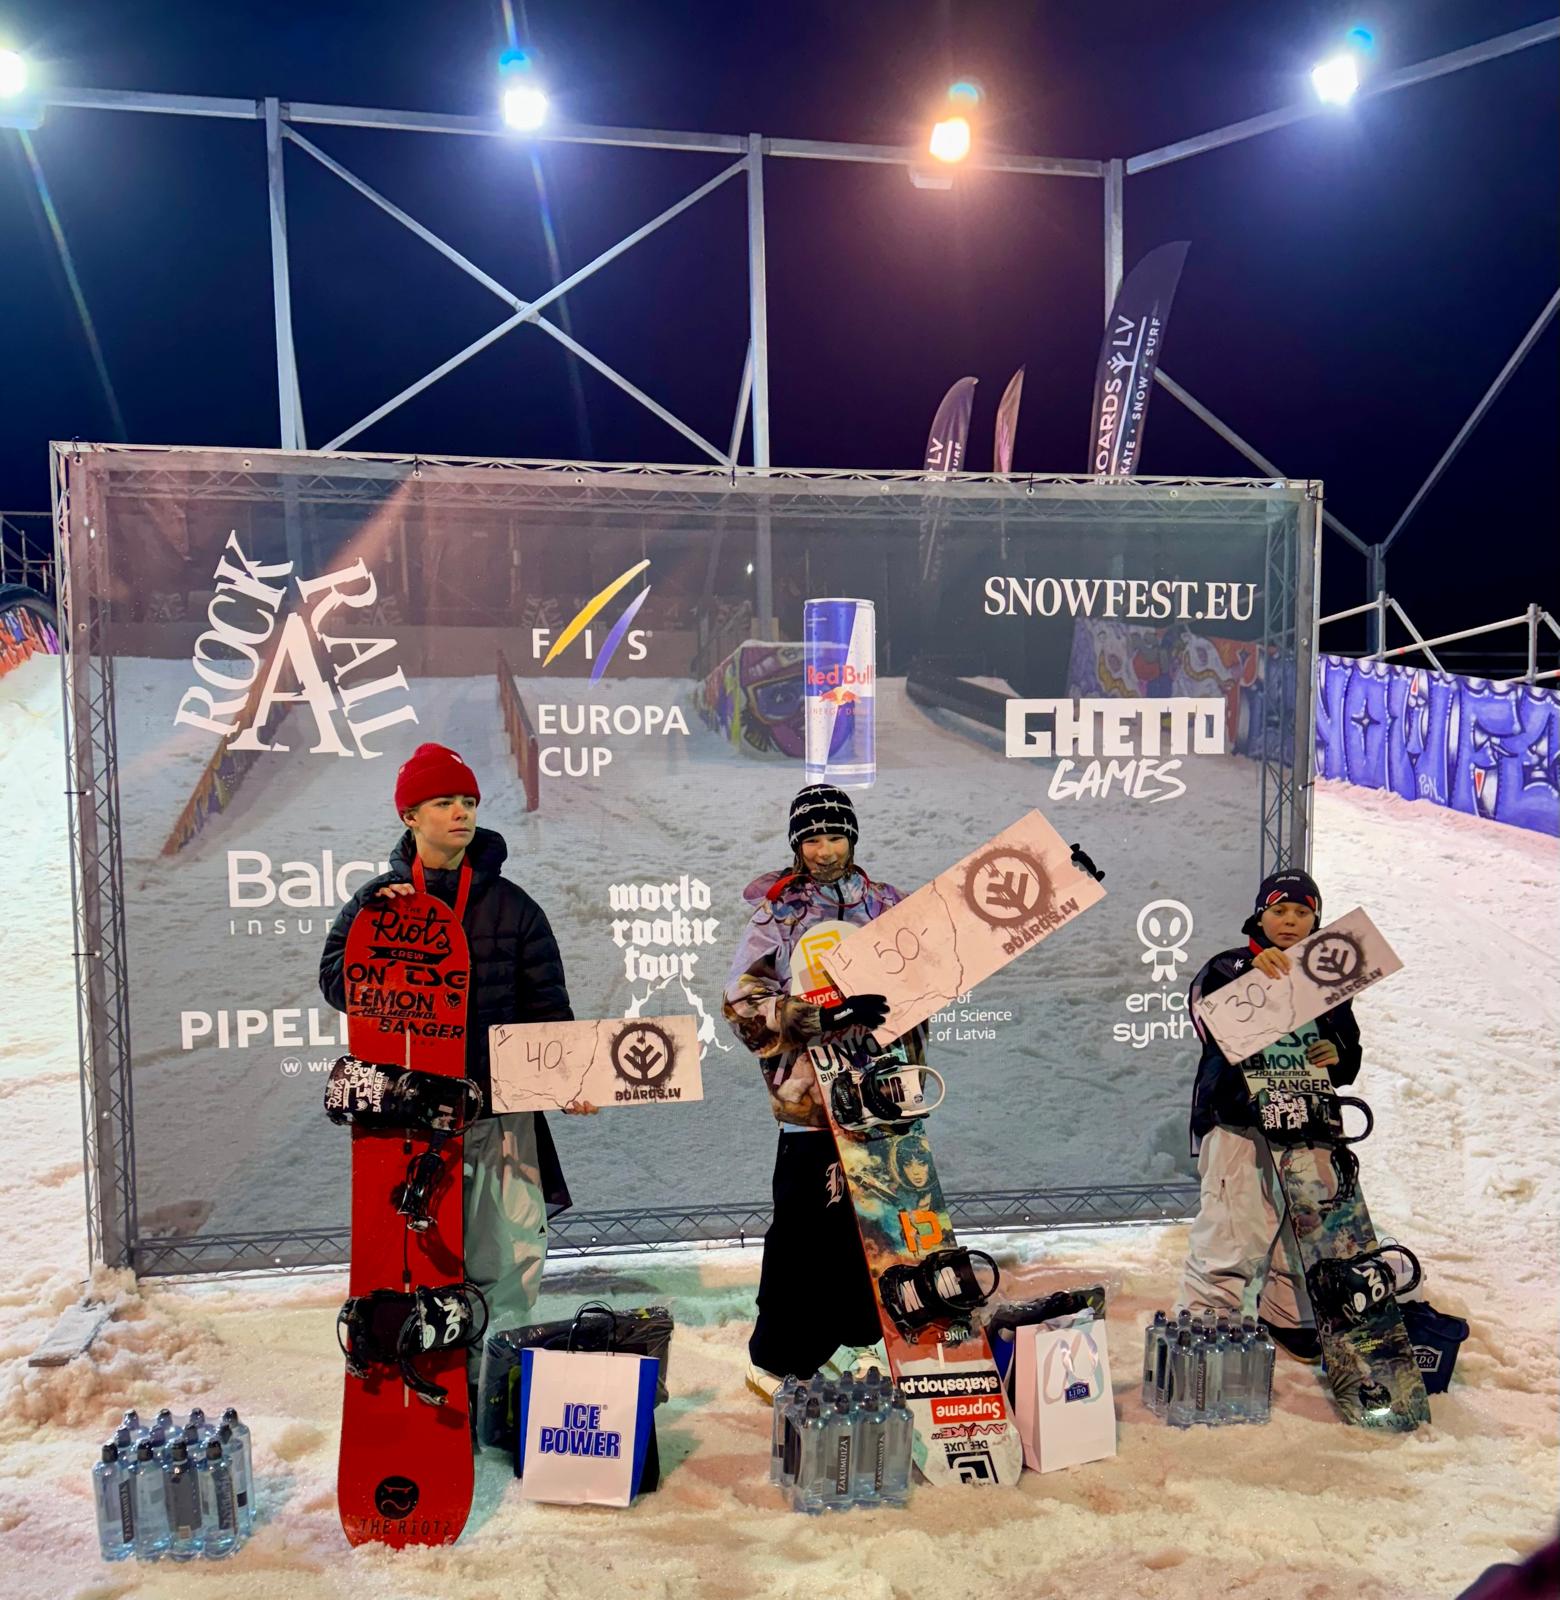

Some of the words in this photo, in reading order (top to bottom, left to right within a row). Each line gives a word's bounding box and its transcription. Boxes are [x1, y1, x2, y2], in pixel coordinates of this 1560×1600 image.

[1111, 314, 1136, 346] LV
[1132, 376, 1149, 420] SNOW
[1145, 317, 1161, 357] SURF
[983, 576, 1258, 621] SNOWFEST.EU
[173, 529, 294, 738] ROCK
[295, 556, 420, 760] RAIL
[807, 663, 839, 685] Red
[843, 664, 873, 686] Bull
[537, 704, 691, 736] EUROPA
[1005, 697, 1226, 758] GHETTO
[537, 746, 613, 778] CUP
[1047, 758, 1187, 804] GAMES
[608, 874, 712, 912] world
[371, 903, 452, 950] Riots
[610, 909, 721, 948] rookie
[624, 945, 700, 983] tour
[350, 983, 434, 1012] LEMON
[378, 1016, 465, 1040] BANGER
[929, 1009, 956, 1023] and
[960, 1009, 1013, 1022] Science
[936, 1027, 952, 1042] of
[955, 1026, 996, 1041] Latvia
[563, 1402, 601, 1431] ICE
[936, 1399, 1001, 1419] Supreme
[538, 1426, 622, 1459] POWER
